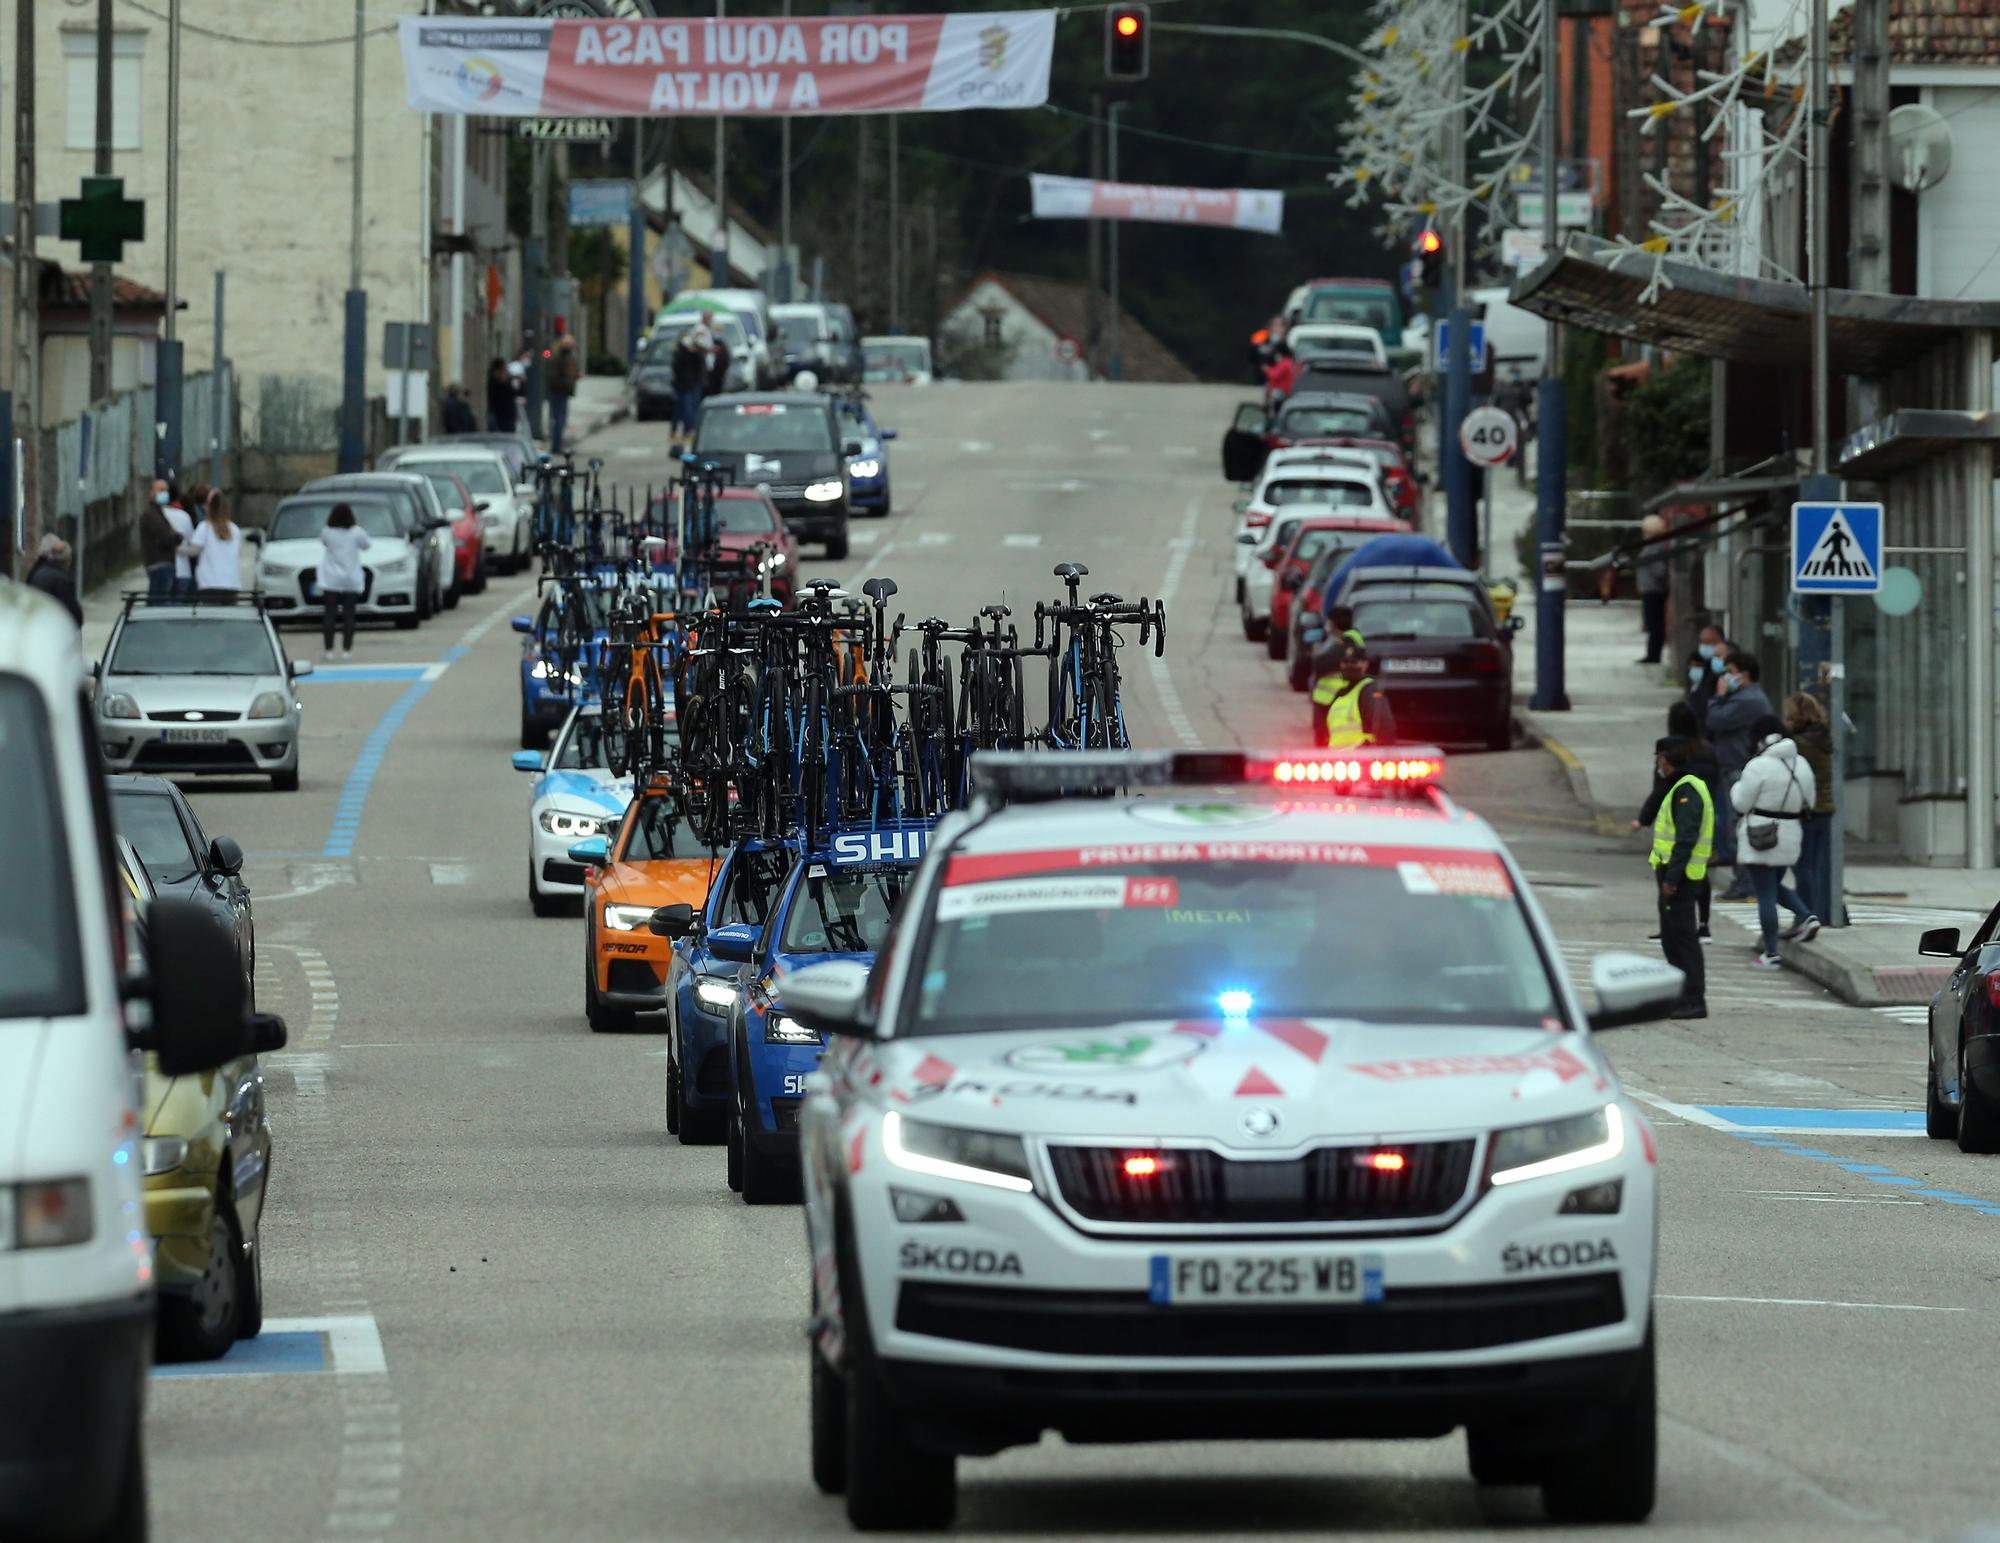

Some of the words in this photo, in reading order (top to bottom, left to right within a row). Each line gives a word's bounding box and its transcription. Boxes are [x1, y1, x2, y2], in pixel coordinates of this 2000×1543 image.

[520, 119, 612, 138] PIZZERIA
[1472, 426, 1506, 445] 40
[1080, 846, 1199, 865] PRUEBA
[1207, 844, 1369, 862] DEPORTIVA
[1131, 883, 1170, 899] 121
[1170, 910, 1243, 924] META
[717, 931, 750, 939] SHIMANO
